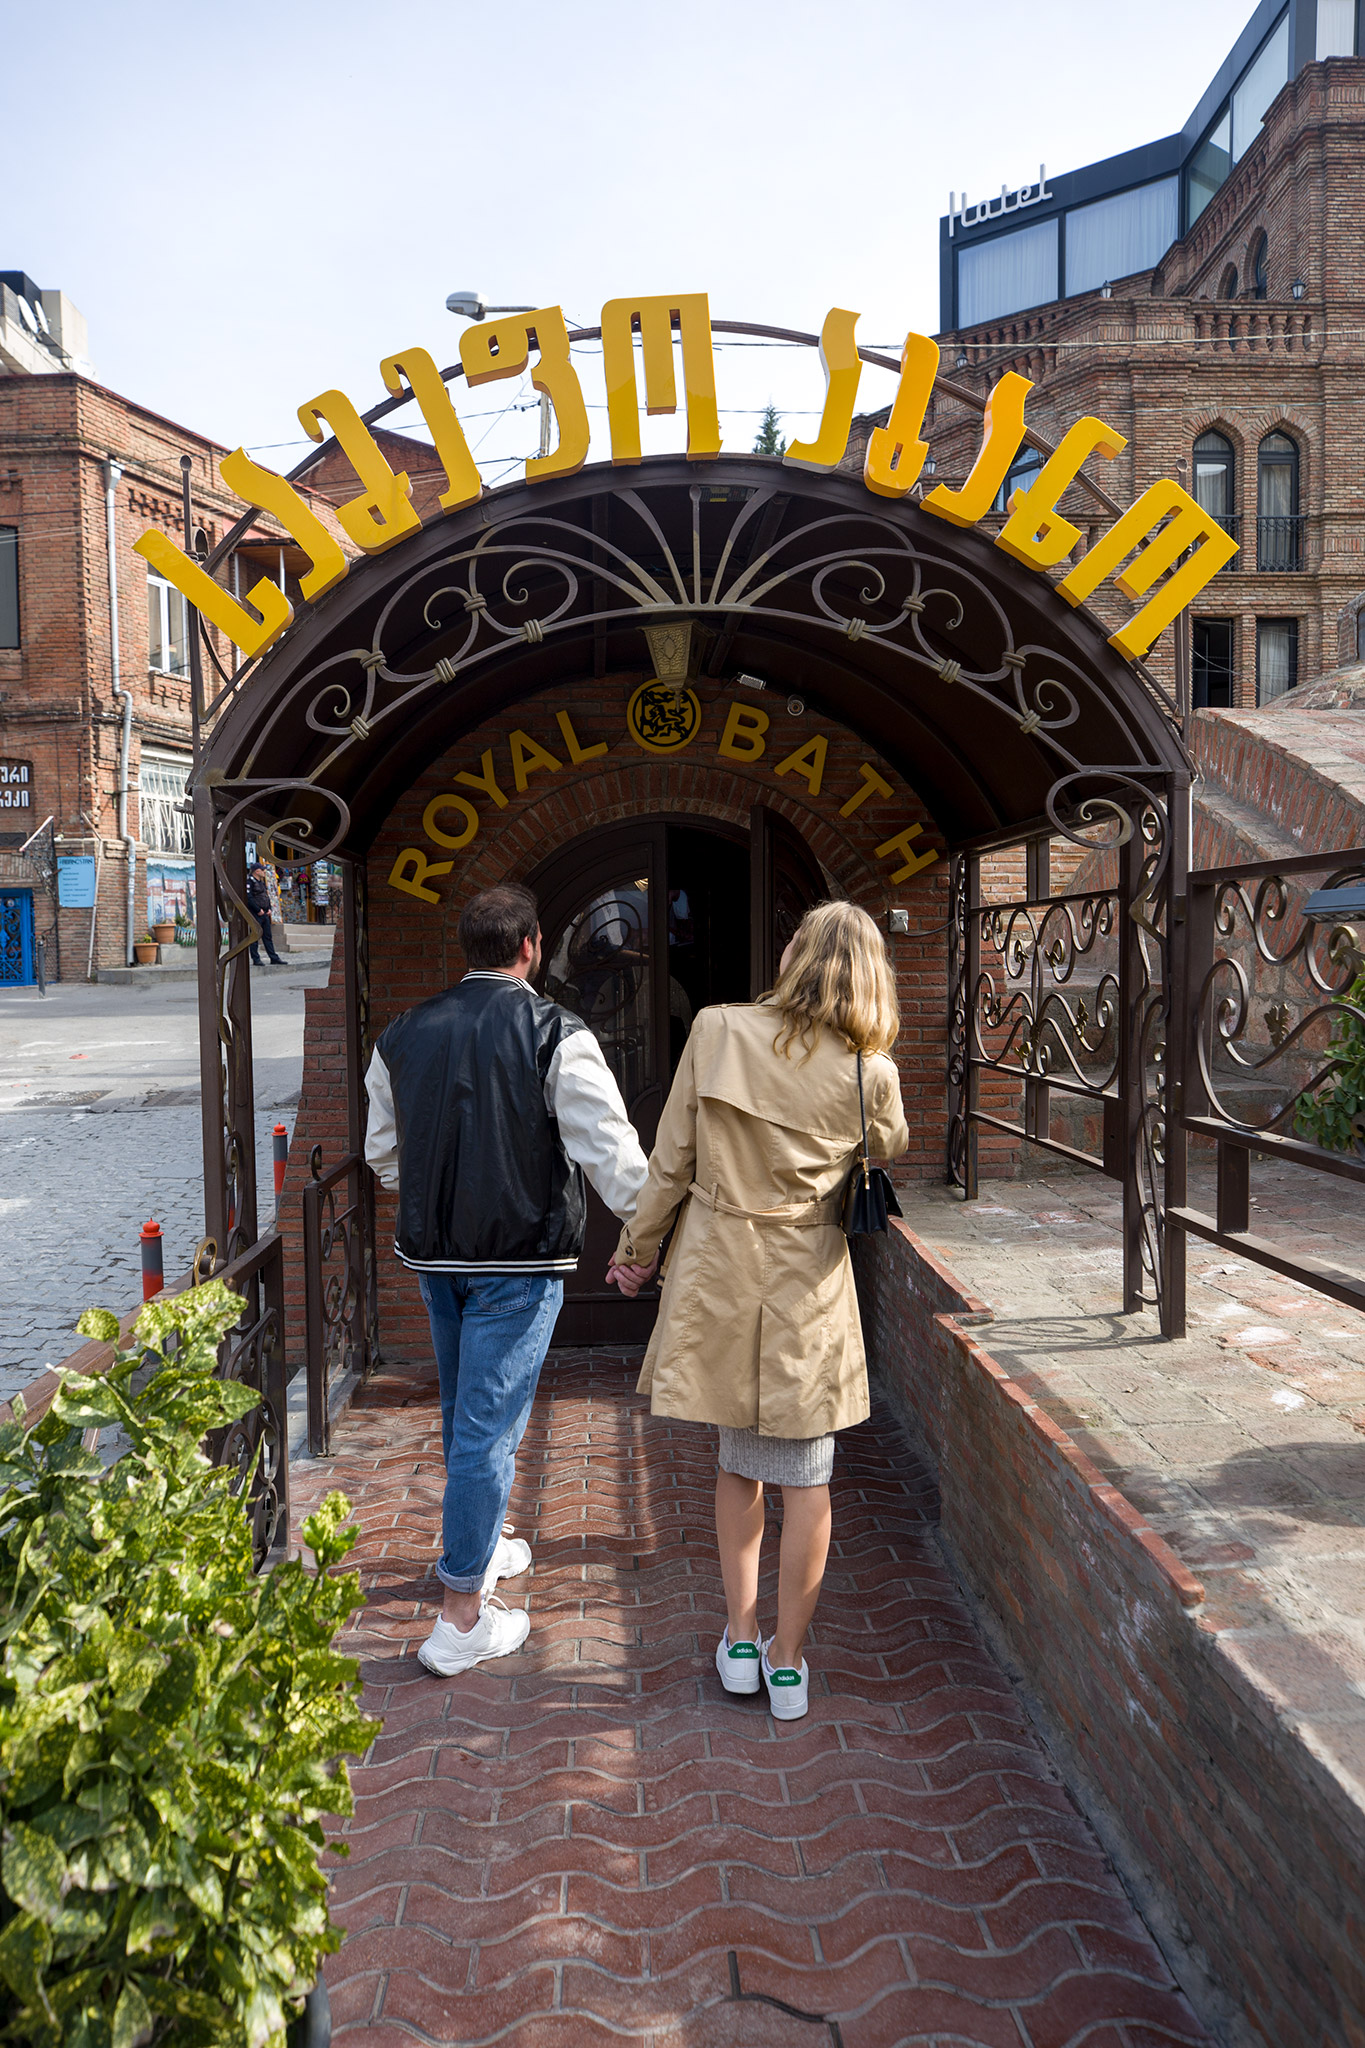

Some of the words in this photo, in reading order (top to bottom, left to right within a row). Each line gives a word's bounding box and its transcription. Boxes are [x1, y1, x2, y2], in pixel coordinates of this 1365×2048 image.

[949, 163, 1053, 238] Hotel
[131, 292, 724, 661] სამეფო
[782, 307, 1241, 662] აბანო
[387, 710, 609, 905] ROYAL
[717, 702, 940, 885] BATH
